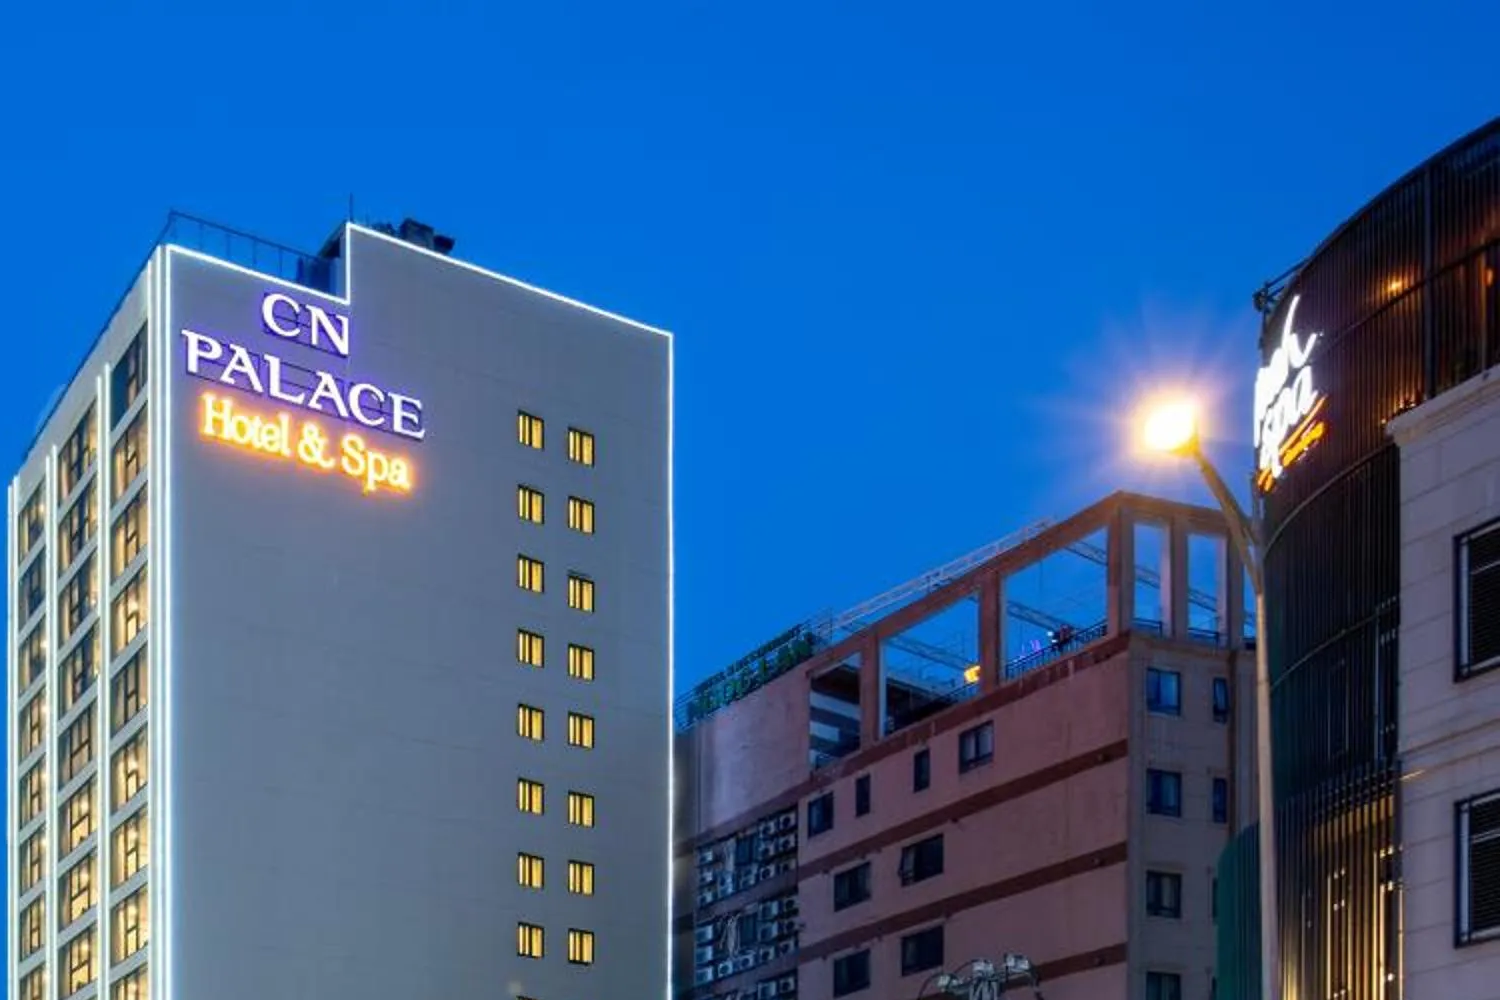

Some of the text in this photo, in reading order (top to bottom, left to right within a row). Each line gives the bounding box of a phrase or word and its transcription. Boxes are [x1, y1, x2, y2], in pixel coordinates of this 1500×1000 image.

[262, 293, 350, 355] CN
[182, 330, 425, 438] PALACE
[201, 394, 412, 492] Hotel & Spa
